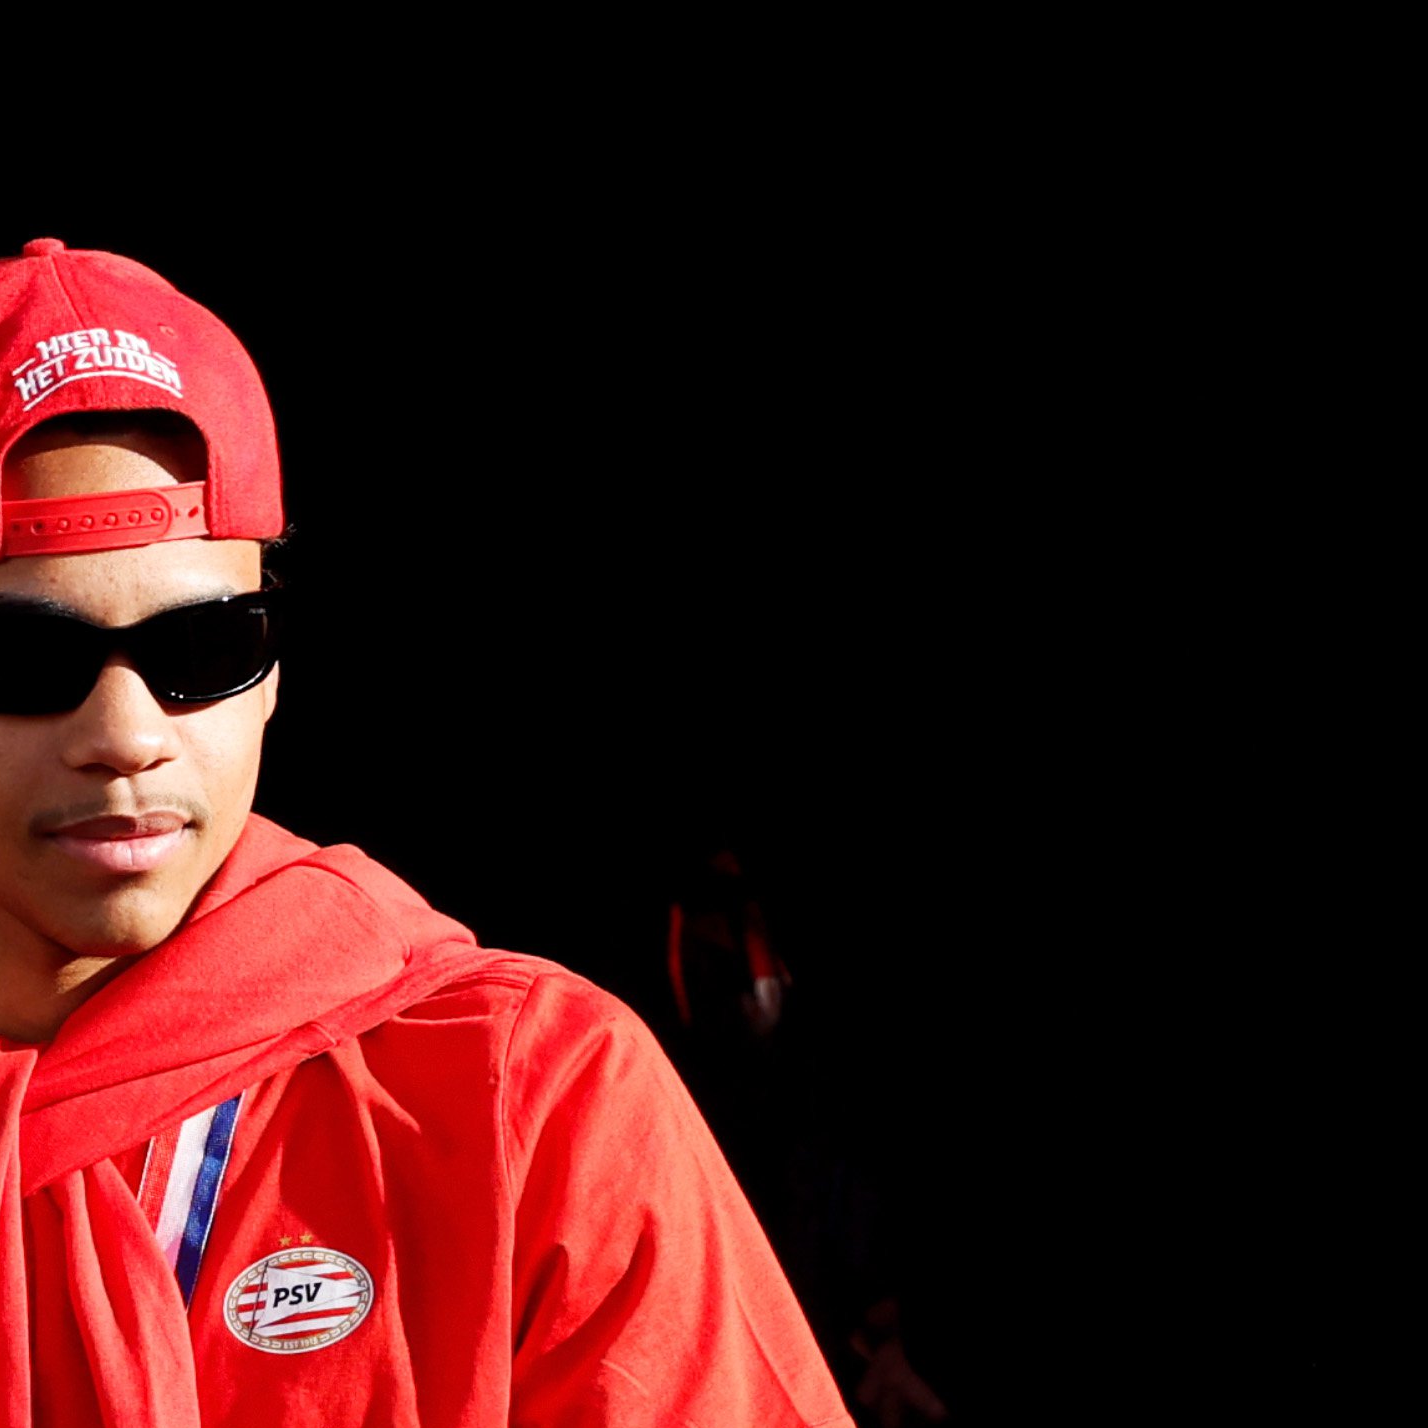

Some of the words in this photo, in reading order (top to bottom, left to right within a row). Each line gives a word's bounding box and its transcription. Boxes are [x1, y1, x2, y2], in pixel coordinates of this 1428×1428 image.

[36, 328, 111, 361] HIER
[114, 329, 150, 354] IN
[14, 354, 67, 401] HET
[72, 346, 182, 390] ZUIDEN
[273, 1282, 322, 1308] PSV
